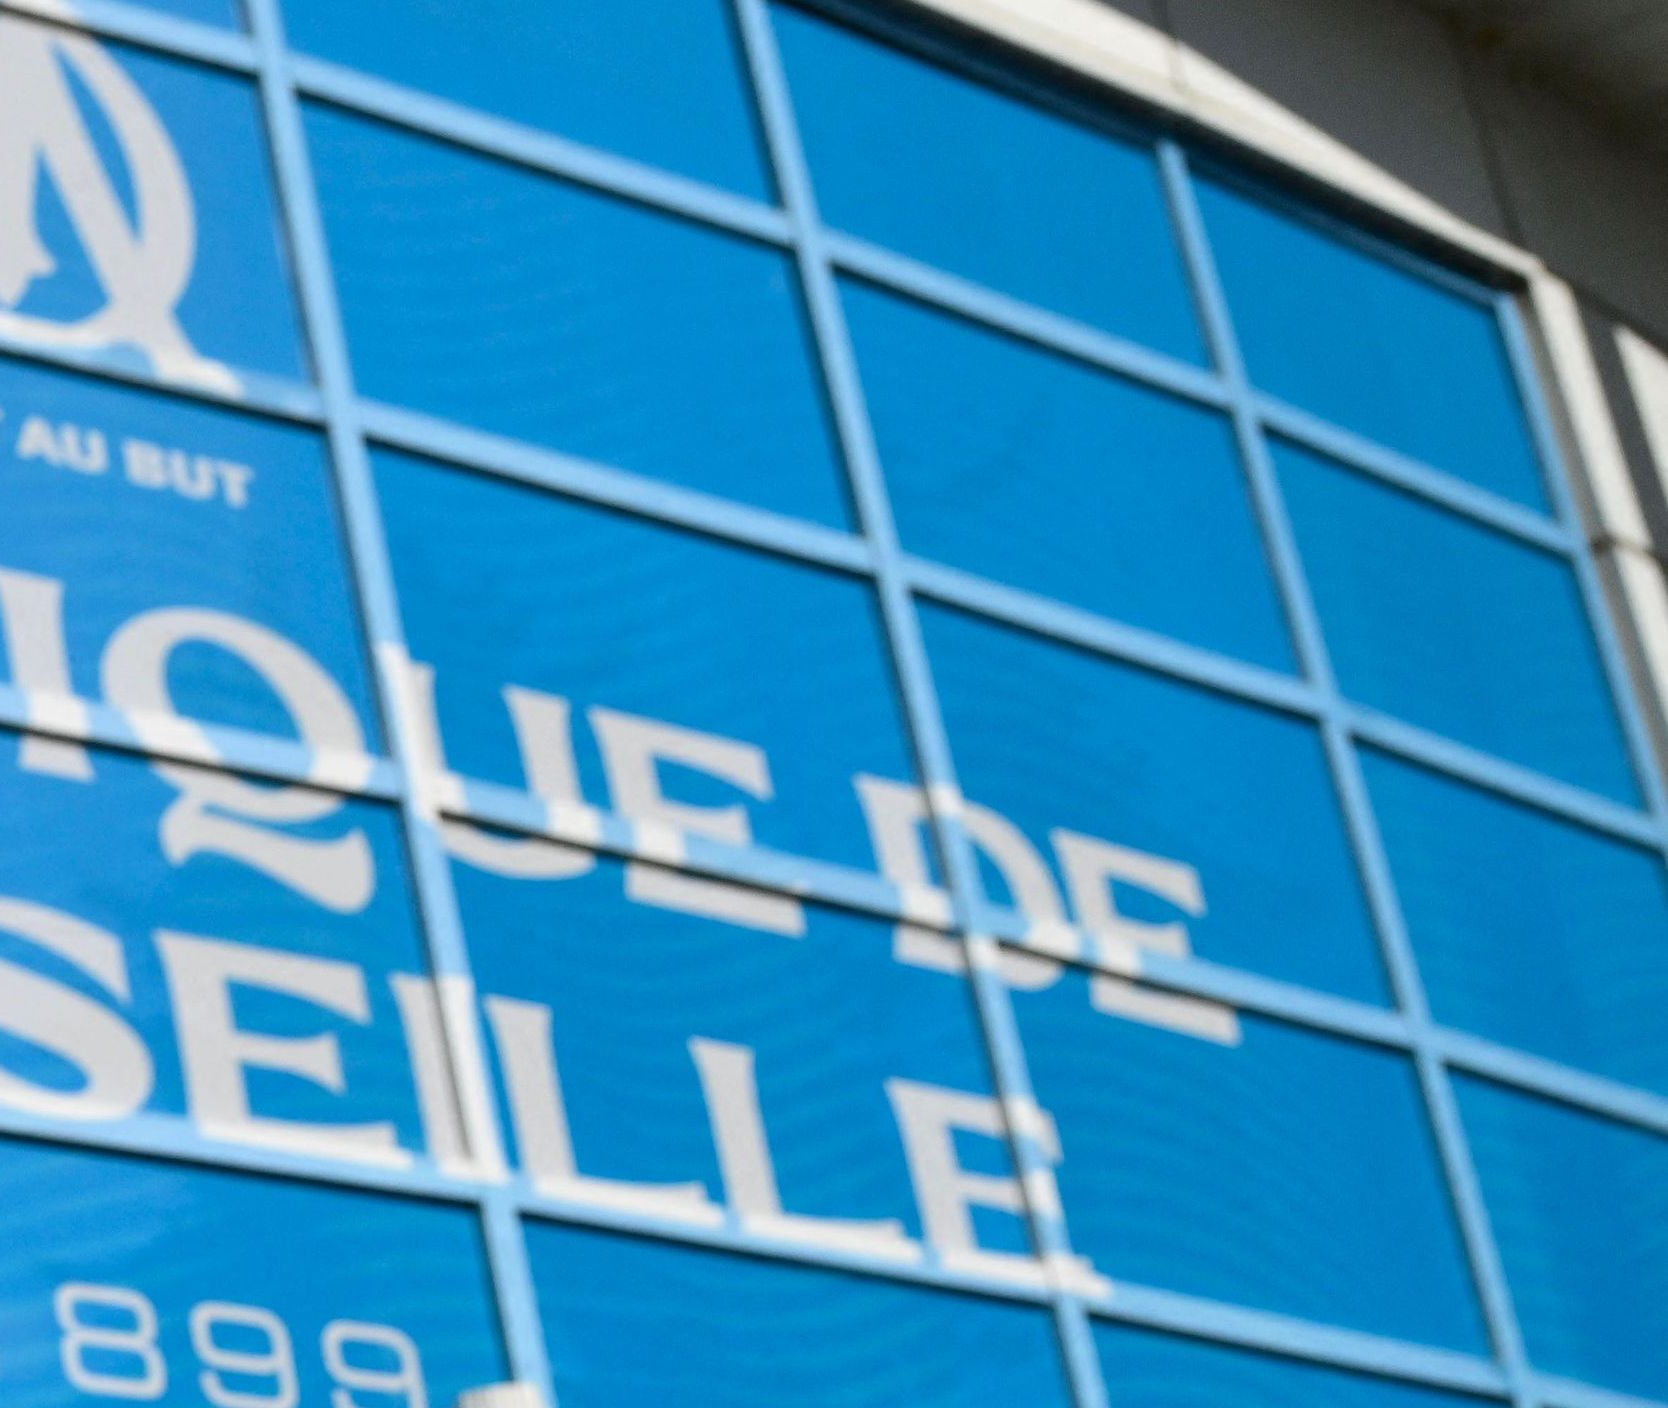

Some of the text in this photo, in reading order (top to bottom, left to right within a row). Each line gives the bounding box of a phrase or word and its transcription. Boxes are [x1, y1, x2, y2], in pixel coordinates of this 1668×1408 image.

[16, 414, 107, 475] AU
[122, 437, 255, 508] BUT
[854, 772, 1241, 1047] DE
